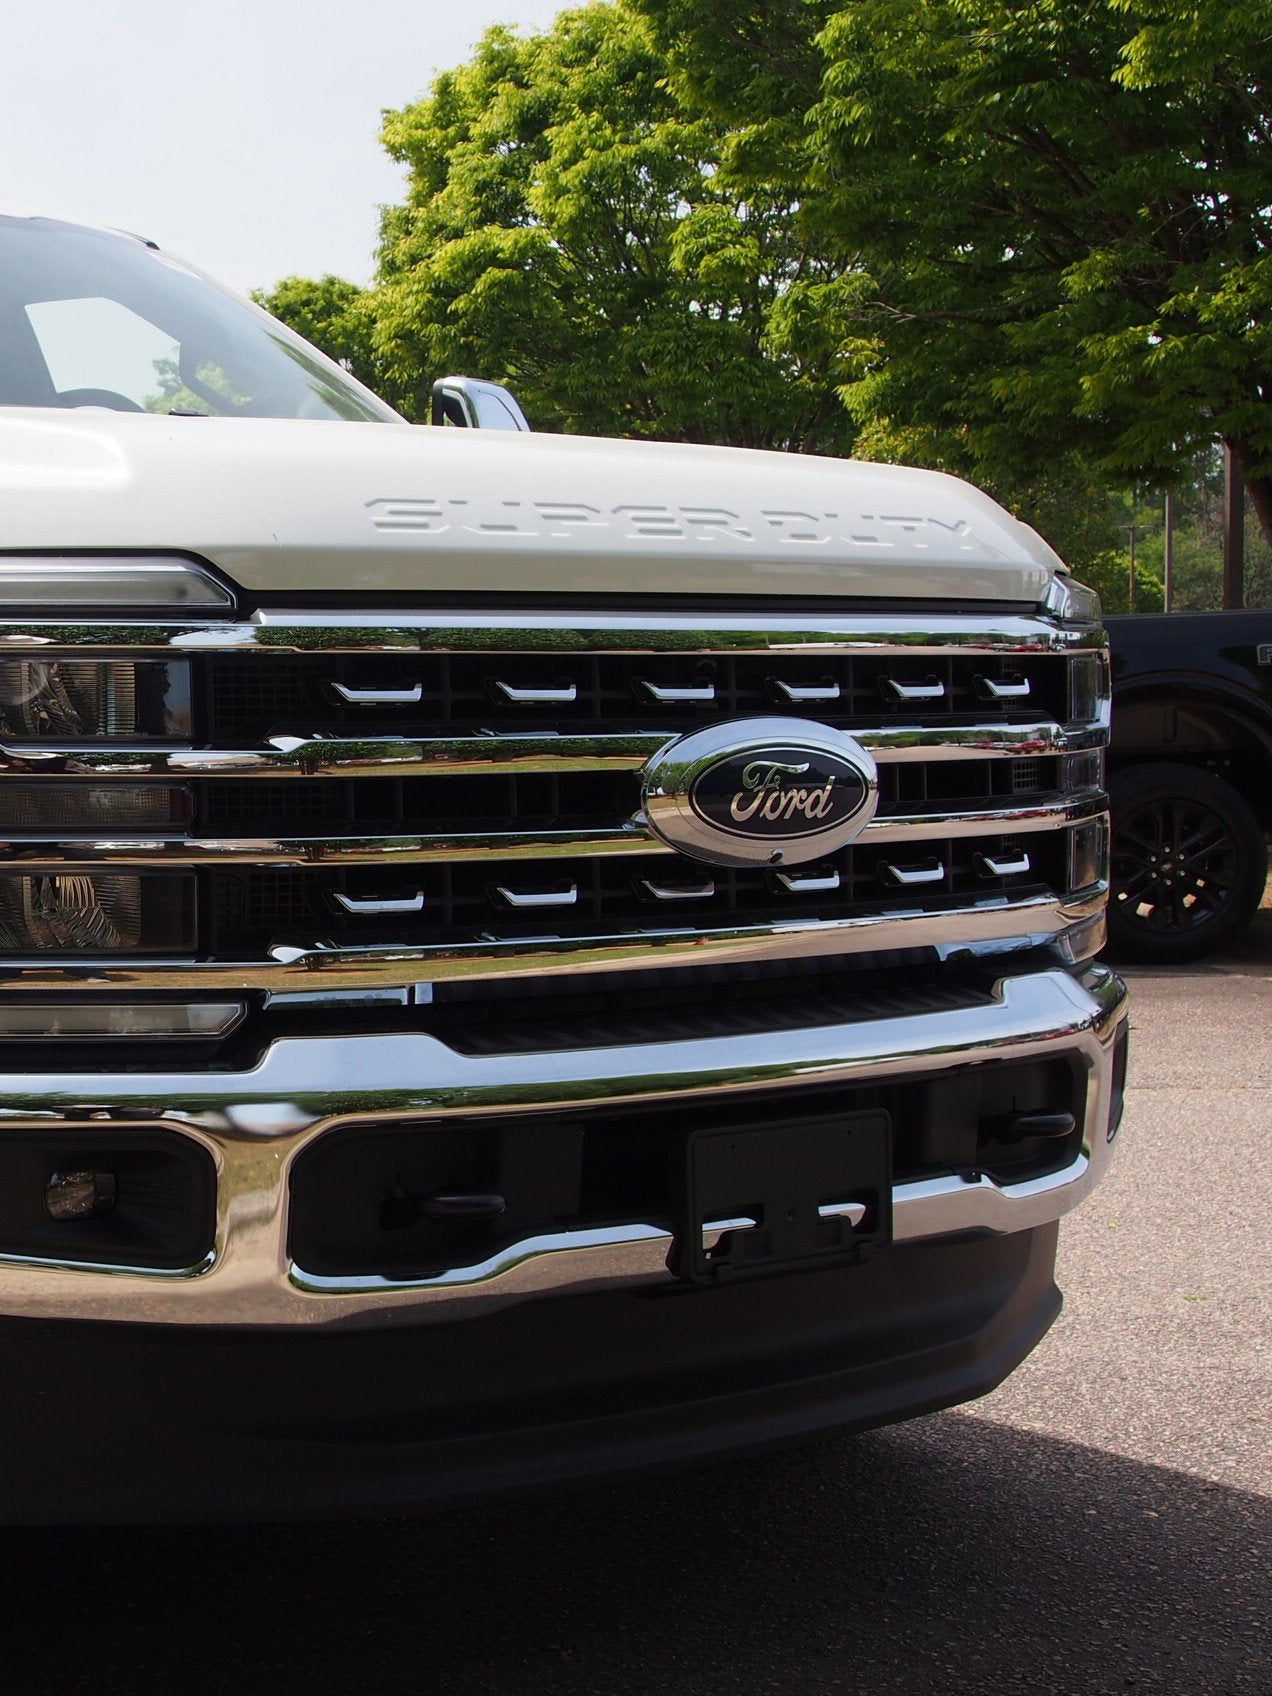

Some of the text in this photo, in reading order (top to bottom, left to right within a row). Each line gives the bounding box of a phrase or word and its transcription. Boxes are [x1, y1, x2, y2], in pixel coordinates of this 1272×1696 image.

[364, 496, 976, 550] SUPER DUTY
[730, 760, 836, 822] Ford
